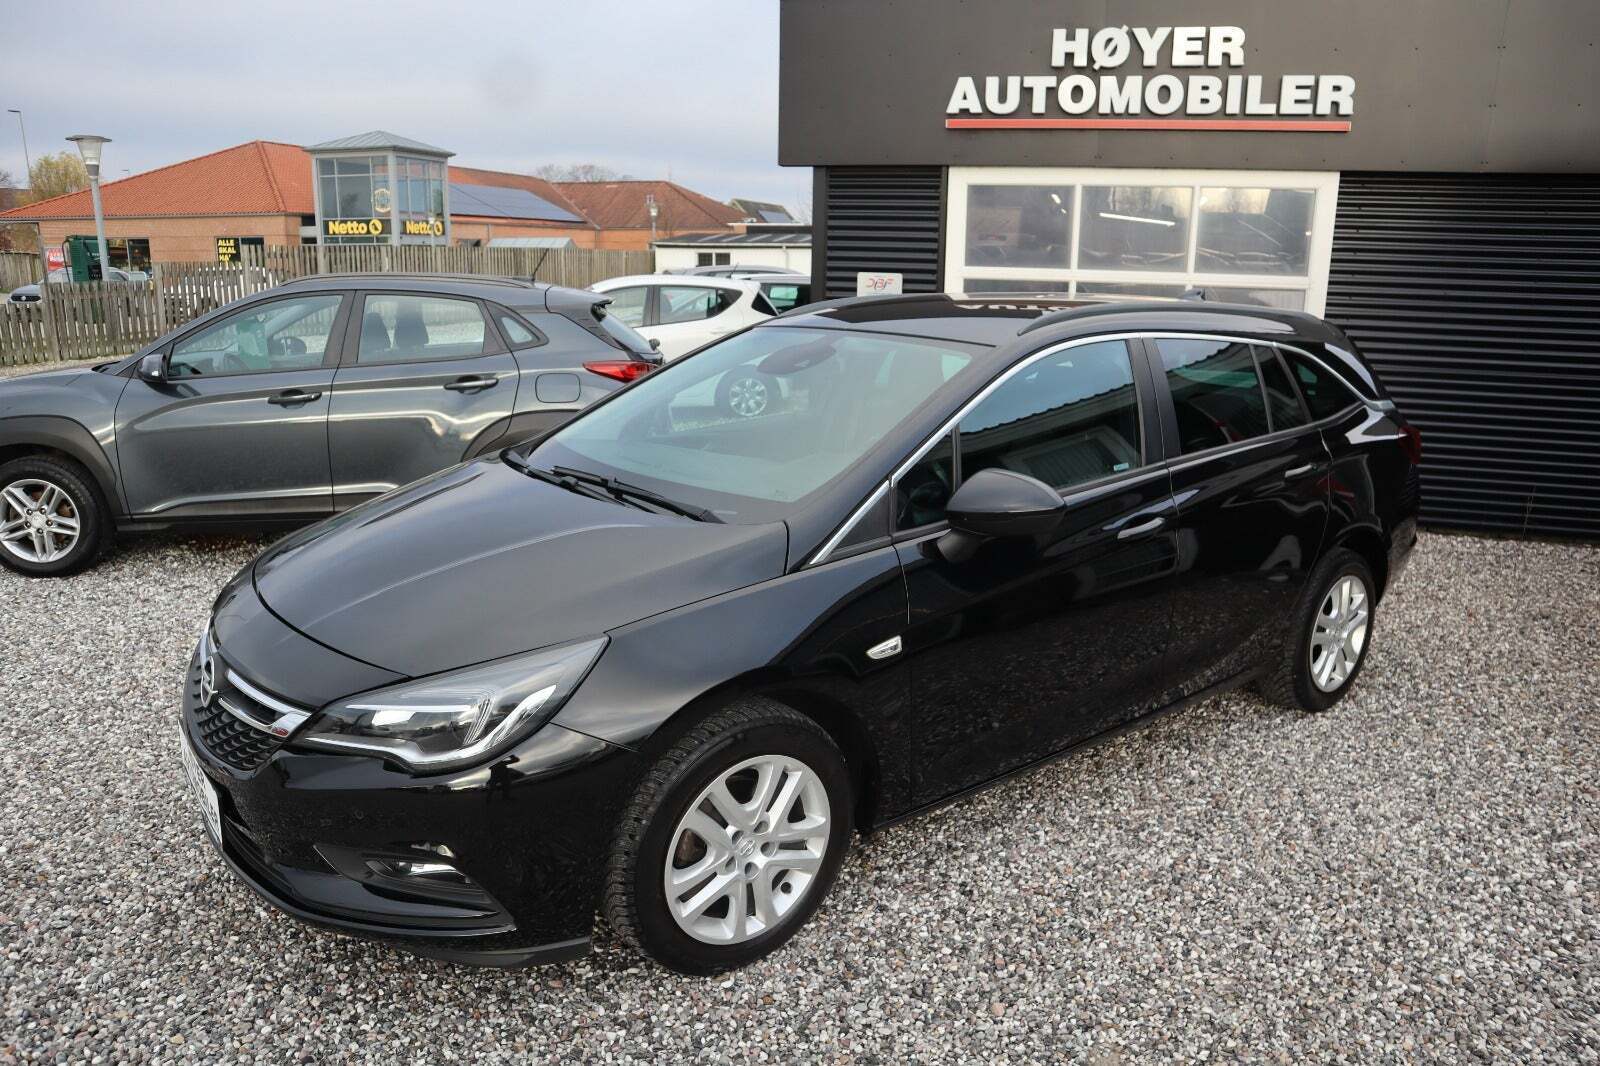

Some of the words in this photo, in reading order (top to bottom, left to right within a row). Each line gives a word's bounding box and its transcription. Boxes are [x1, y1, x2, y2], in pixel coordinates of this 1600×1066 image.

[1051, 25, 1246, 71] HØYER
[945, 74, 1356, 115] AUTOMOBILER
[328, 220, 368, 235] Netto
[405, 221, 433, 235] Netto
[217, 239, 235, 247] ALLE
